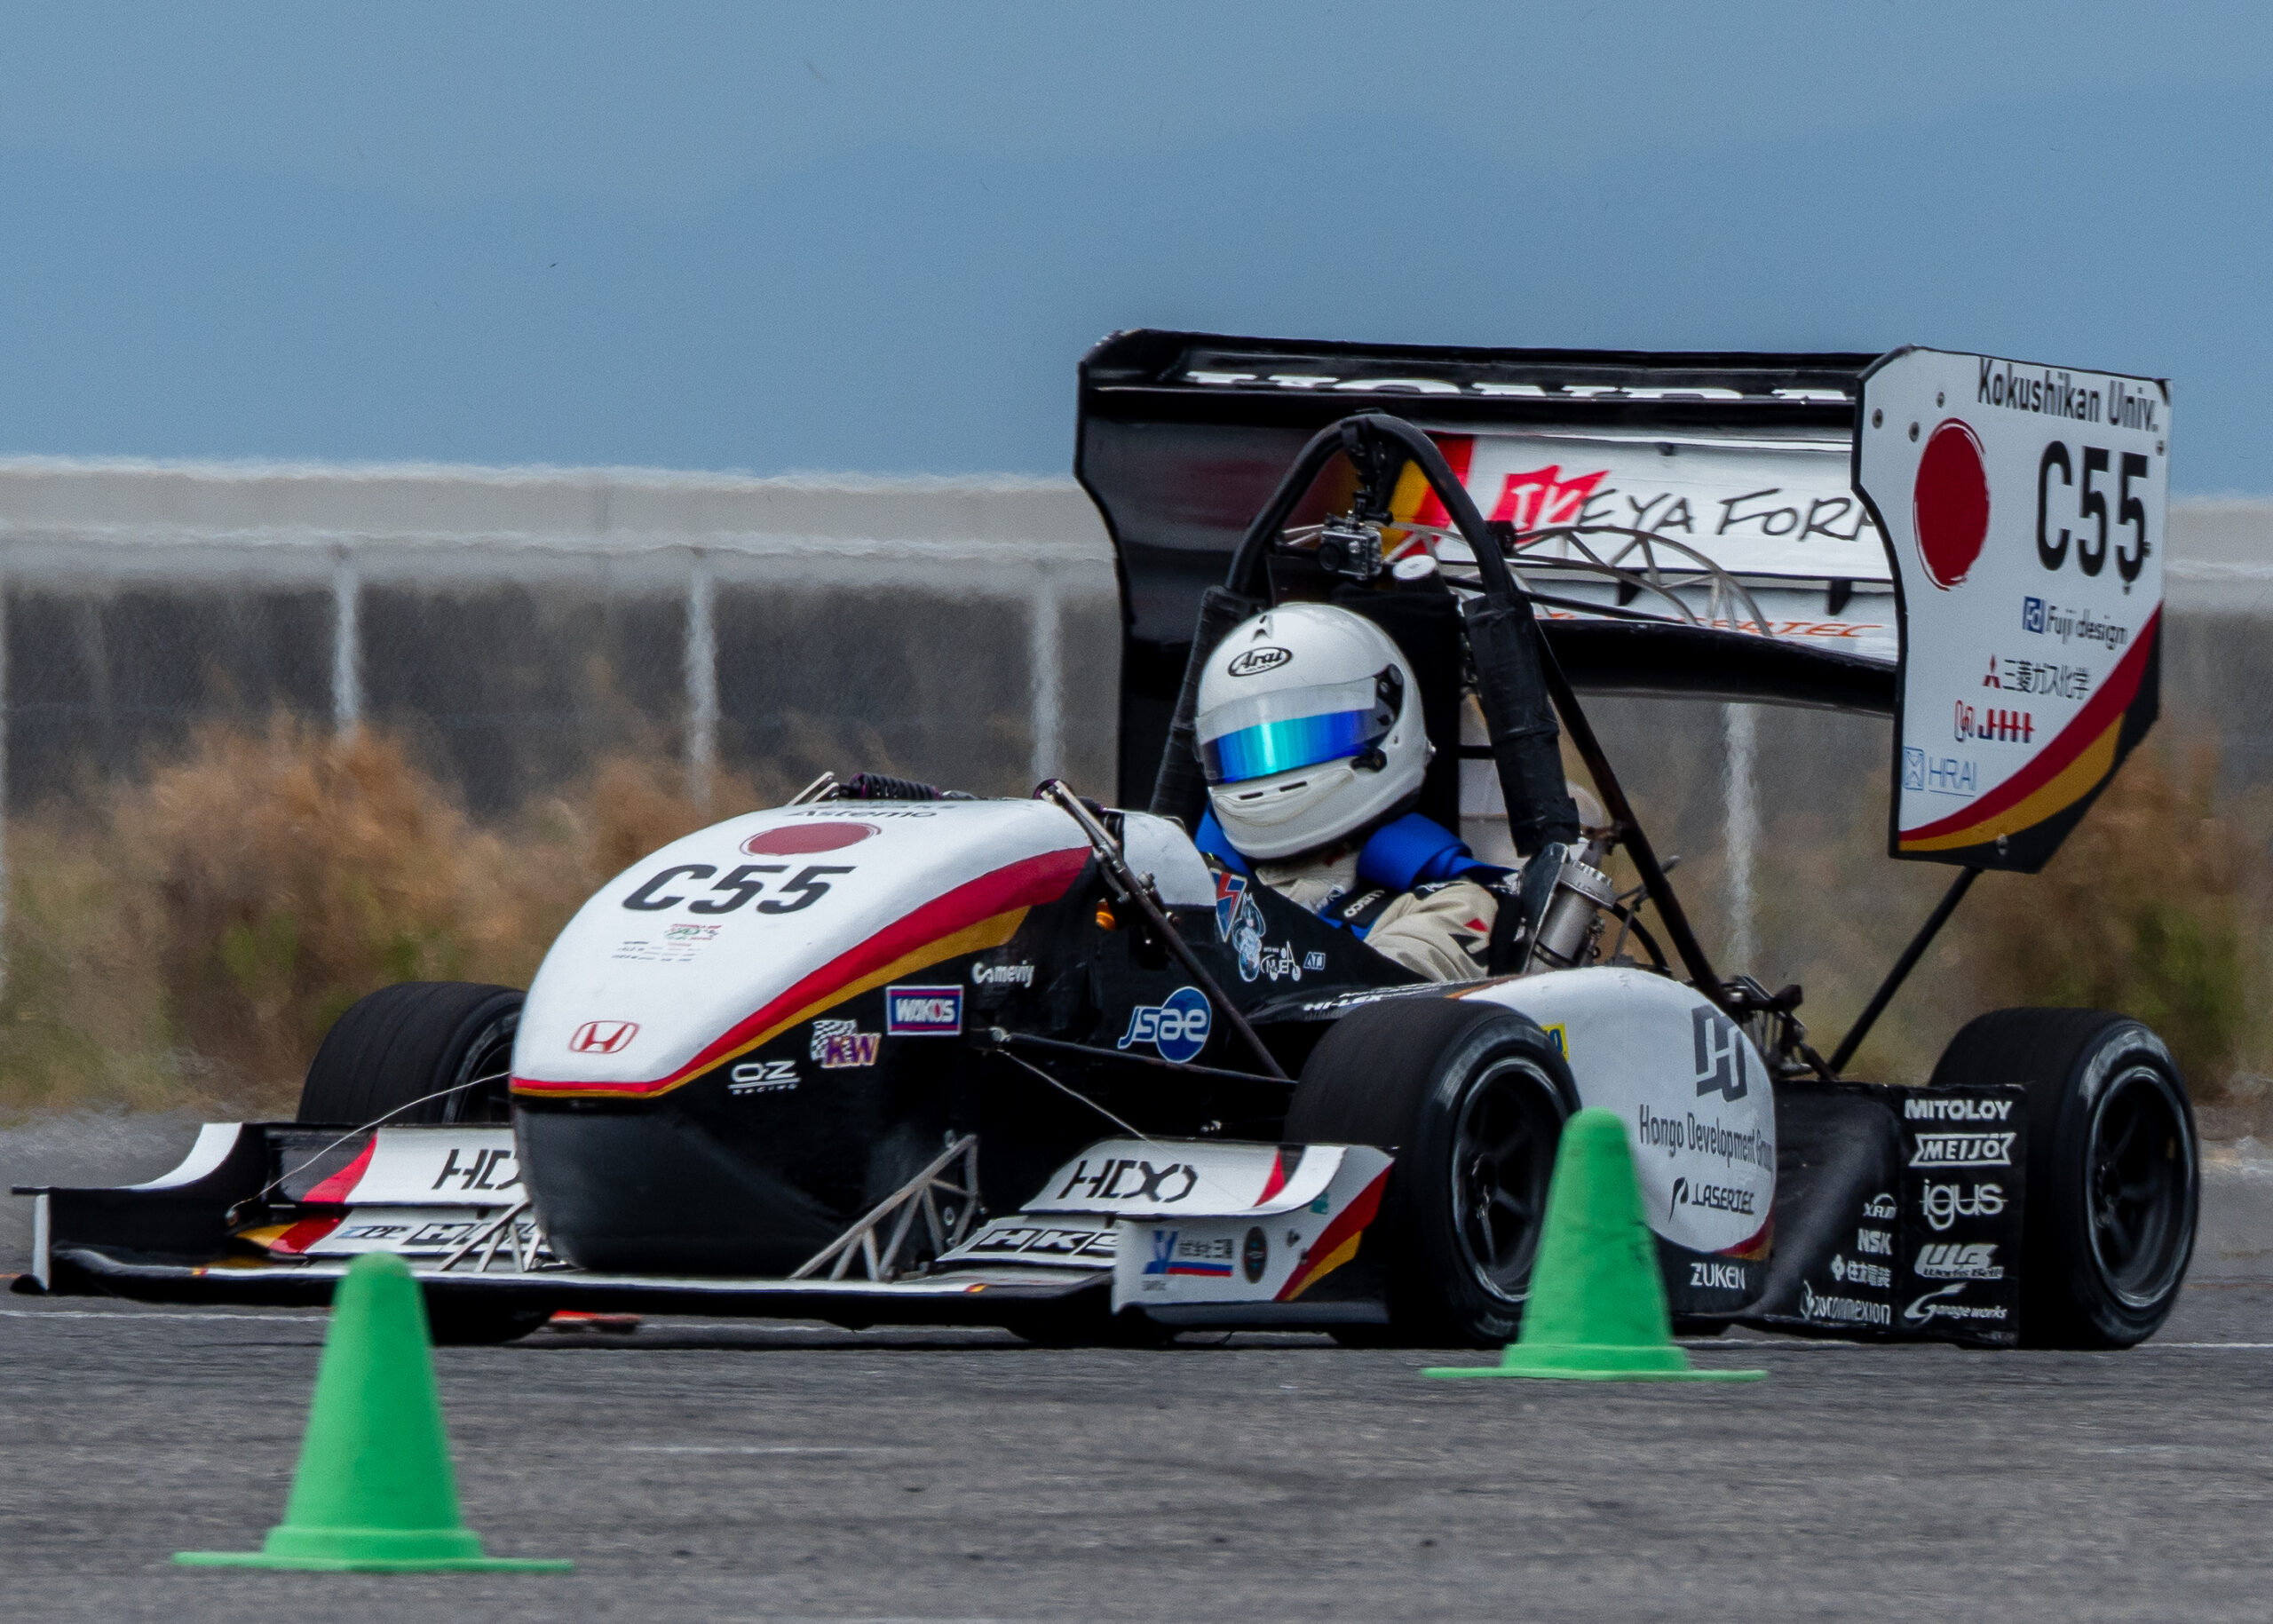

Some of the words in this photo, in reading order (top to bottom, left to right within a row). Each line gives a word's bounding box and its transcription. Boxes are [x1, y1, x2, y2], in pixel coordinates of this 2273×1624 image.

[1977, 357, 2101, 423] Kokushikan
[2109, 380, 2160, 433] Univ.
[2036, 440, 2149, 583] C55
[1237, 652, 1282, 669] Arai
[622, 863, 858, 915] C55
[732, 1059, 797, 1082] OZ
[1905, 1099, 2013, 1121] MITOLOY
[1640, 1104, 1684, 1158] Hongo
[1687, 1112, 1755, 1168] Development
[1691, 1183, 1755, 1216] LASERTEC
[1921, 1179, 2004, 1231] igus
[1857, 1228, 1893, 1256] NSK
[1690, 1262, 1746, 1290] ZUKEN
